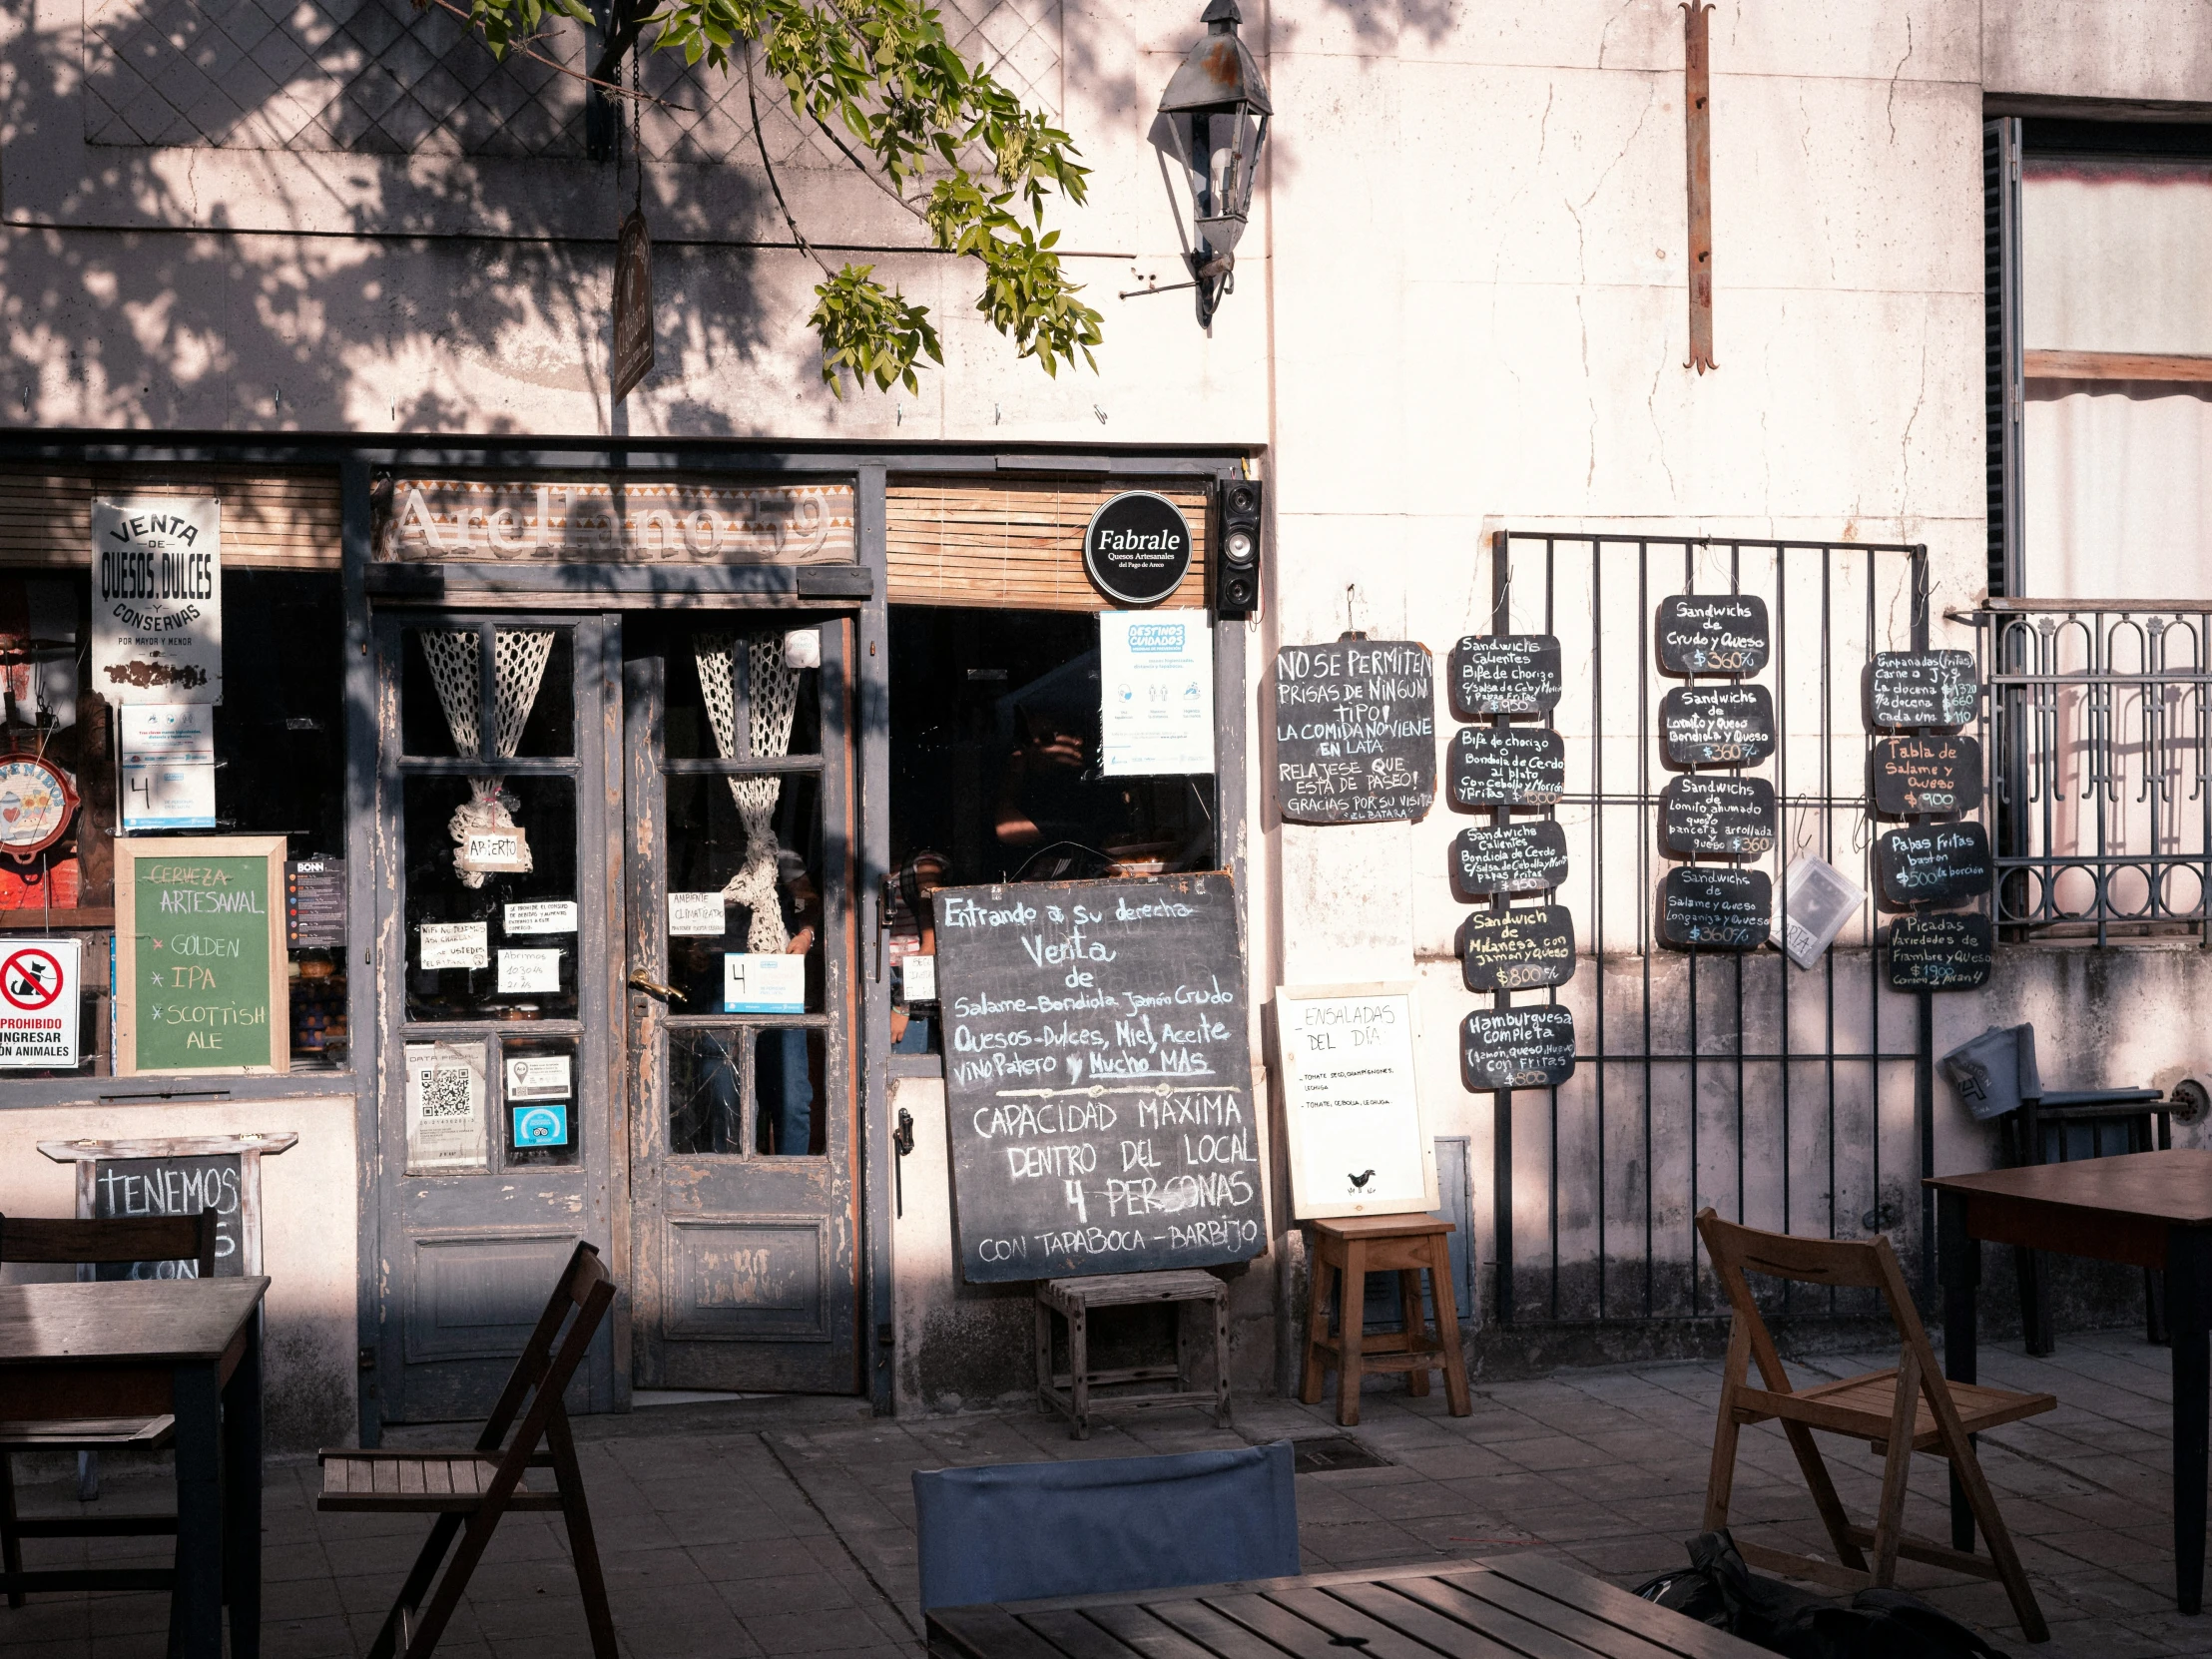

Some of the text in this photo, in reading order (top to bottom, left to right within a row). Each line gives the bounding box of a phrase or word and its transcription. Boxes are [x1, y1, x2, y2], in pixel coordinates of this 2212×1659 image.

[110, 513, 199, 547] VENTA
[396, 488, 830, 559] Arellano 59
[1098, 529, 1181, 550] Fabrale
[1108, 552, 1134, 561] Quesos
[102, 552, 212, 602] QUESOS, DULCES
[113, 603, 201, 631] CONSERVAS
[1677, 602, 1752, 618] Sandwichs
[1130, 626, 1184, 637] DESTINOS
[1703, 618, 1722, 630] de
[119, 637, 192, 646] POR MAYOR Y MENOR
[1130, 636, 1184, 646] CUIDADOS
[1667, 631, 1765, 651] Crudo y Queso
[1277, 647, 1432, 681] NO SE PERMITEN
[1694, 649, 1741, 669] $360
[1278, 678, 1427, 704] PRISAS DE NINGUN
[1277, 718, 1432, 741] LA COMIDA NO VIENE
[1320, 740, 1383, 757] EN LATA
[1889, 740, 1957, 760] Tabla de
[1280, 758, 1404, 782] RELAJESE QUE
[1886, 761, 1952, 777] Salame y
[1340, 778, 1358, 793] DE
[1367, 772, 1417, 791] PASEO!
[1682, 779, 1755, 796] Sandwichs
[1908, 777, 1954, 790] Queso
[132, 778, 150, 810] 4
[1706, 794, 1721, 804] de
[1288, 795, 1433, 815] GRACIAS POR SU VISITA
[1670, 800, 1762, 815] Lomito ahumado
[1669, 825, 1773, 836] panceta arrollada
[470, 838, 517, 856] ABIERTO
[1694, 838, 1725, 849] queso
[1892, 832, 1974, 853] Papas Fritas
[151, 864, 228, 886] CERVEZA
[297, 862, 323, 872] BONN
[1897, 866, 1937, 887] $500
[1937, 867, 1947, 877] la
[160, 889, 265, 914] ARTESANAL
[674, 892, 709, 903] AMBIENTE
[944, 896, 1037, 927] Entrando
[1048, 905, 1065, 923] a
[1115, 897, 1193, 922] derecha
[1473, 909, 1547, 929] Sandwich
[1501, 925, 1518, 938] de
[1906, 917, 1964, 932] Picadas
[171, 934, 240, 958] GOLDEN
[1021, 925, 1117, 967] Venta
[1469, 936, 1566, 953] Milanesa con
[1893, 928, 1978, 946] Variedades de
[1525, 951, 1531, 961] y
[1532, 948, 1568, 960] Queso
[1894, 949, 1991, 964] Fiambre y Queso
[171, 966, 216, 990] IPA
[733, 964, 746, 994] 4
[1065, 965, 1094, 988] de
[1496, 967, 1541, 986] $800
[1175, 974, 1234, 1005] Crudo
[1, 1018, 62, 1029] PROHIBIDO
[1306, 1005, 1394, 1025] ENSALADAS
[1469, 1012, 1573, 1034] Hamburguesa
[0, 1032, 61, 1043] INGRESAR
[187, 1030, 223, 1049] ALE
[1115, 1013, 1158, 1054] Miel,
[1162, 1012, 1232, 1045] Aceite
[1308, 1032, 1337, 1051] DEL
[16, 1046, 69, 1056] ANIMALES
[993, 1052, 1056, 1078] Patero
[1089, 1050, 1150, 1074] Mucho
[1504, 1071, 1547, 1086] $800
[973, 1099, 1117, 1139] CAPACIDAD
[1007, 1128, 1258, 1178] DENTRO DEL LOCAL
[98, 1168, 239, 1215] TENEMOS
[1065, 1171, 1254, 1224] 4 PERSONAS
[979, 1236, 1026, 1263] CON
[1034, 1227, 1145, 1257] TAPABOCA
